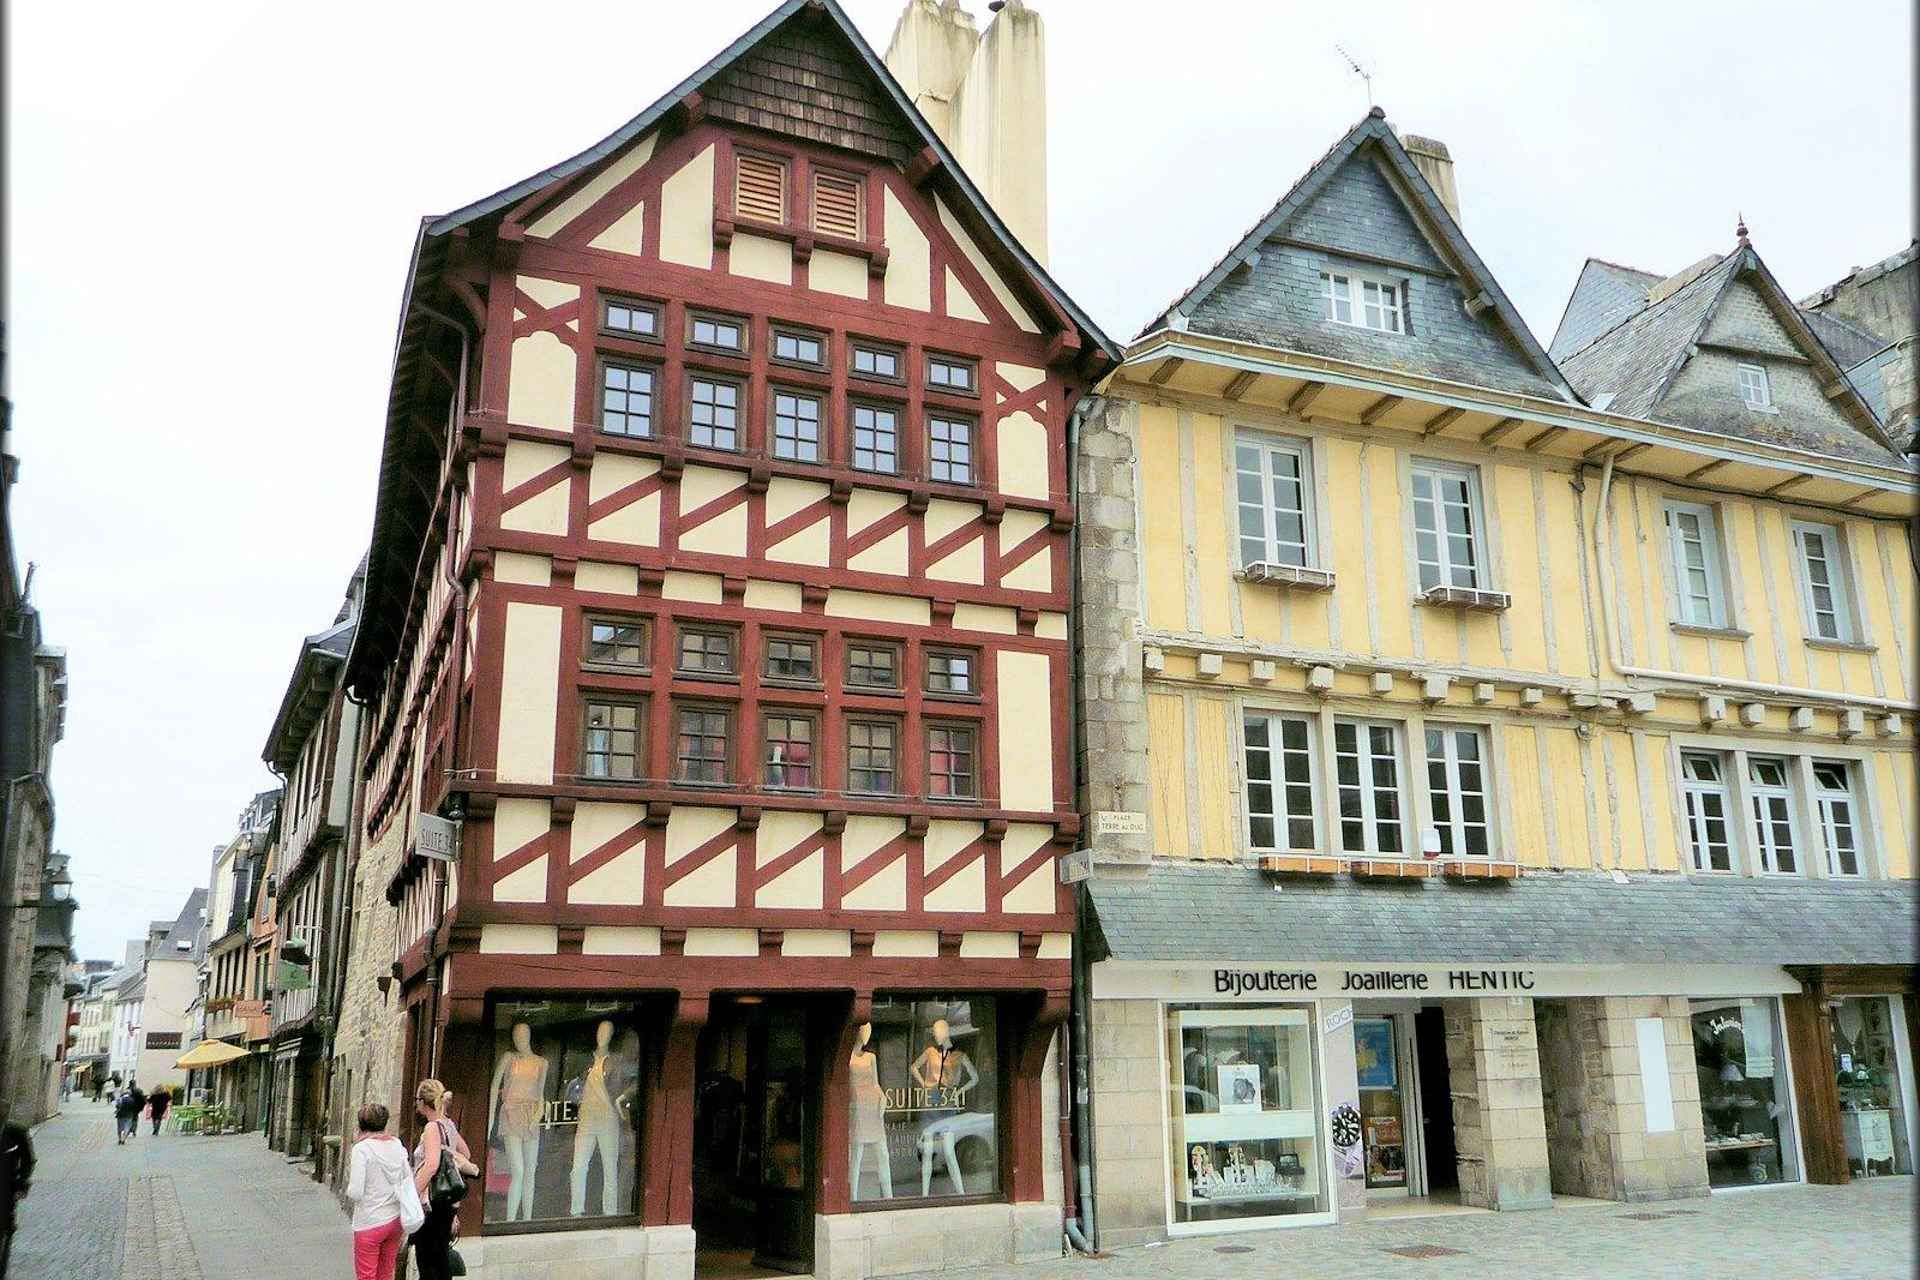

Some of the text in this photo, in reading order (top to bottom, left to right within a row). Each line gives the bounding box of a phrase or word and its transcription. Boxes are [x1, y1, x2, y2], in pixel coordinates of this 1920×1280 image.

[1214, 970, 1535, 996] Bijouterie Joaillerie HENTIC
[885, 1087, 967, 1109] SUITE.341
